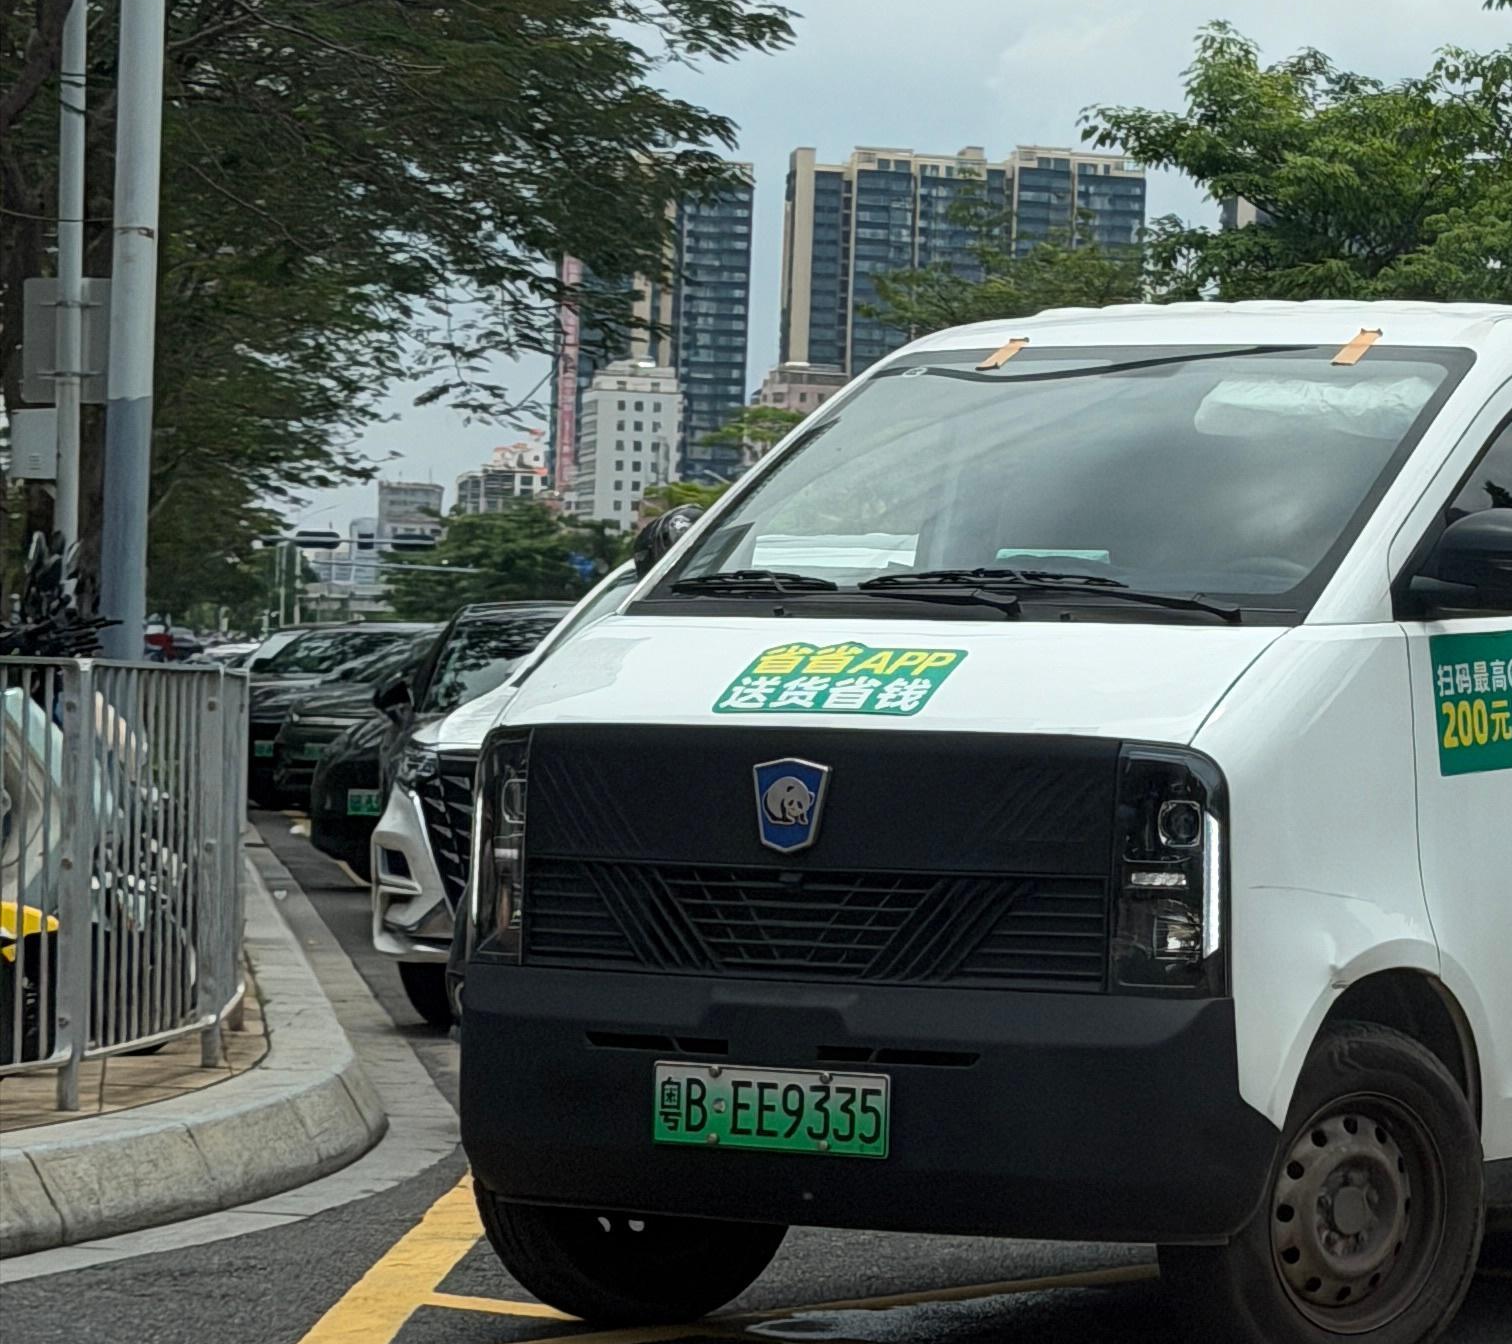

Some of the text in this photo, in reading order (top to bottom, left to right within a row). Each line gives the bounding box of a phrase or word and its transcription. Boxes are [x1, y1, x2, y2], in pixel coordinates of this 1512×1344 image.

[751, 644, 957, 676] 省省APP
[719, 675, 933, 712] 送货省钱
[1441, 698, 1512, 749] 200元
